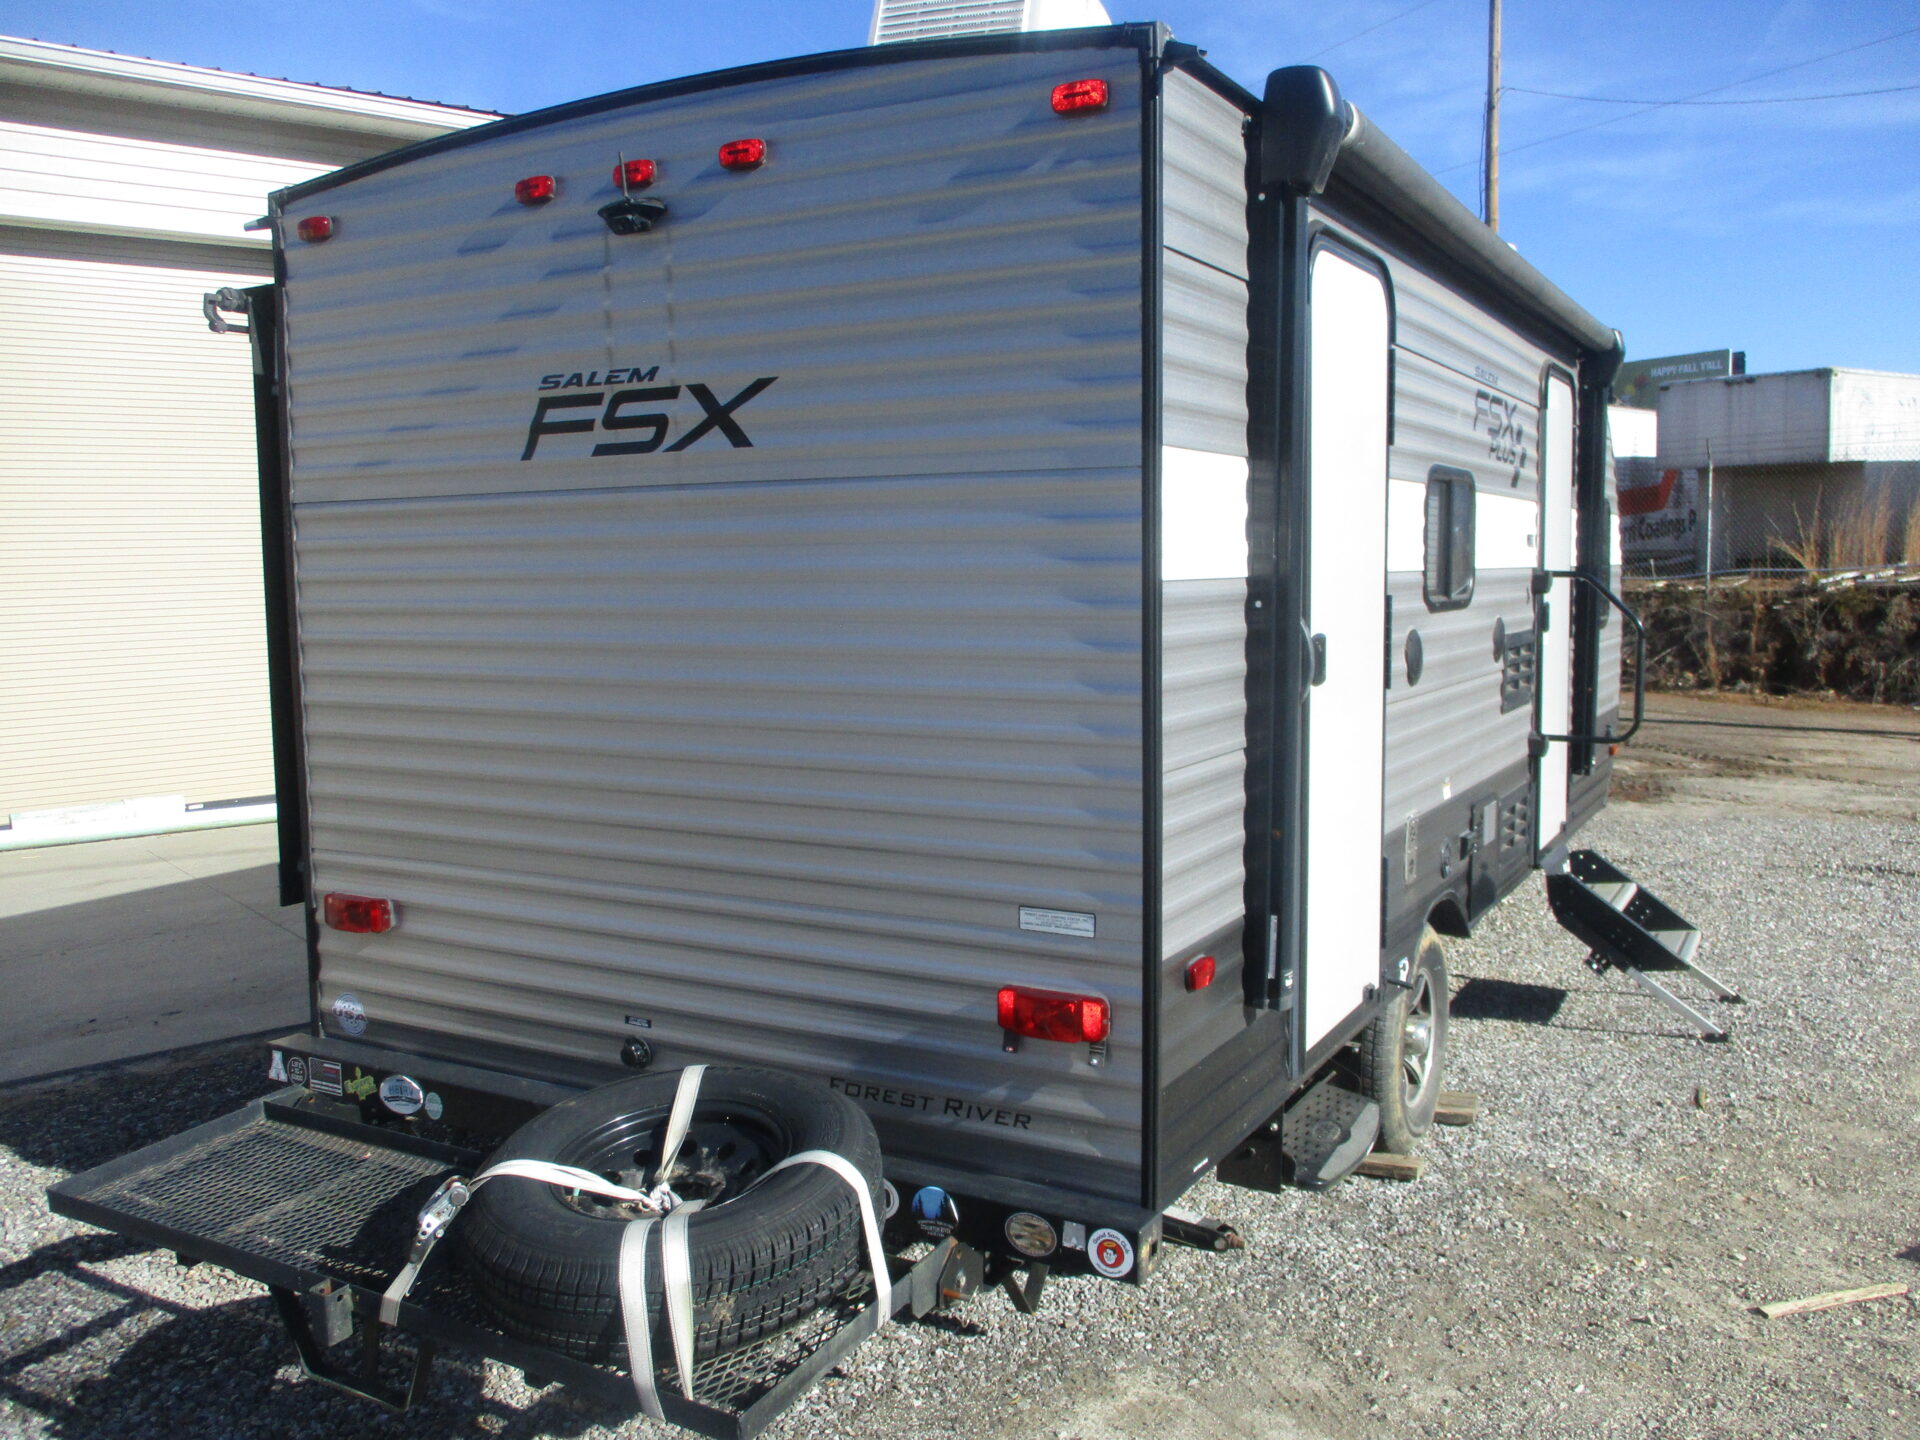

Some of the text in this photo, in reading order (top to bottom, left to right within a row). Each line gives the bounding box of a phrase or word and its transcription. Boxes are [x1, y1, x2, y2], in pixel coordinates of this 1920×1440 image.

[538, 366, 660, 391] SALEM
[1650, 360, 1723, 377] HAPPY FALL Y'ALL
[520, 376, 779, 461] FSX
[1474, 388, 1518, 444] FSX
[1488, 441, 1517, 465] PLUS
[331, 1006, 367, 1023] USA
[830, 1076, 1032, 1130] FOREST RIVER
[1092, 1231, 1107, 1245] Good
[1107, 1231, 1121, 1242] Sam
